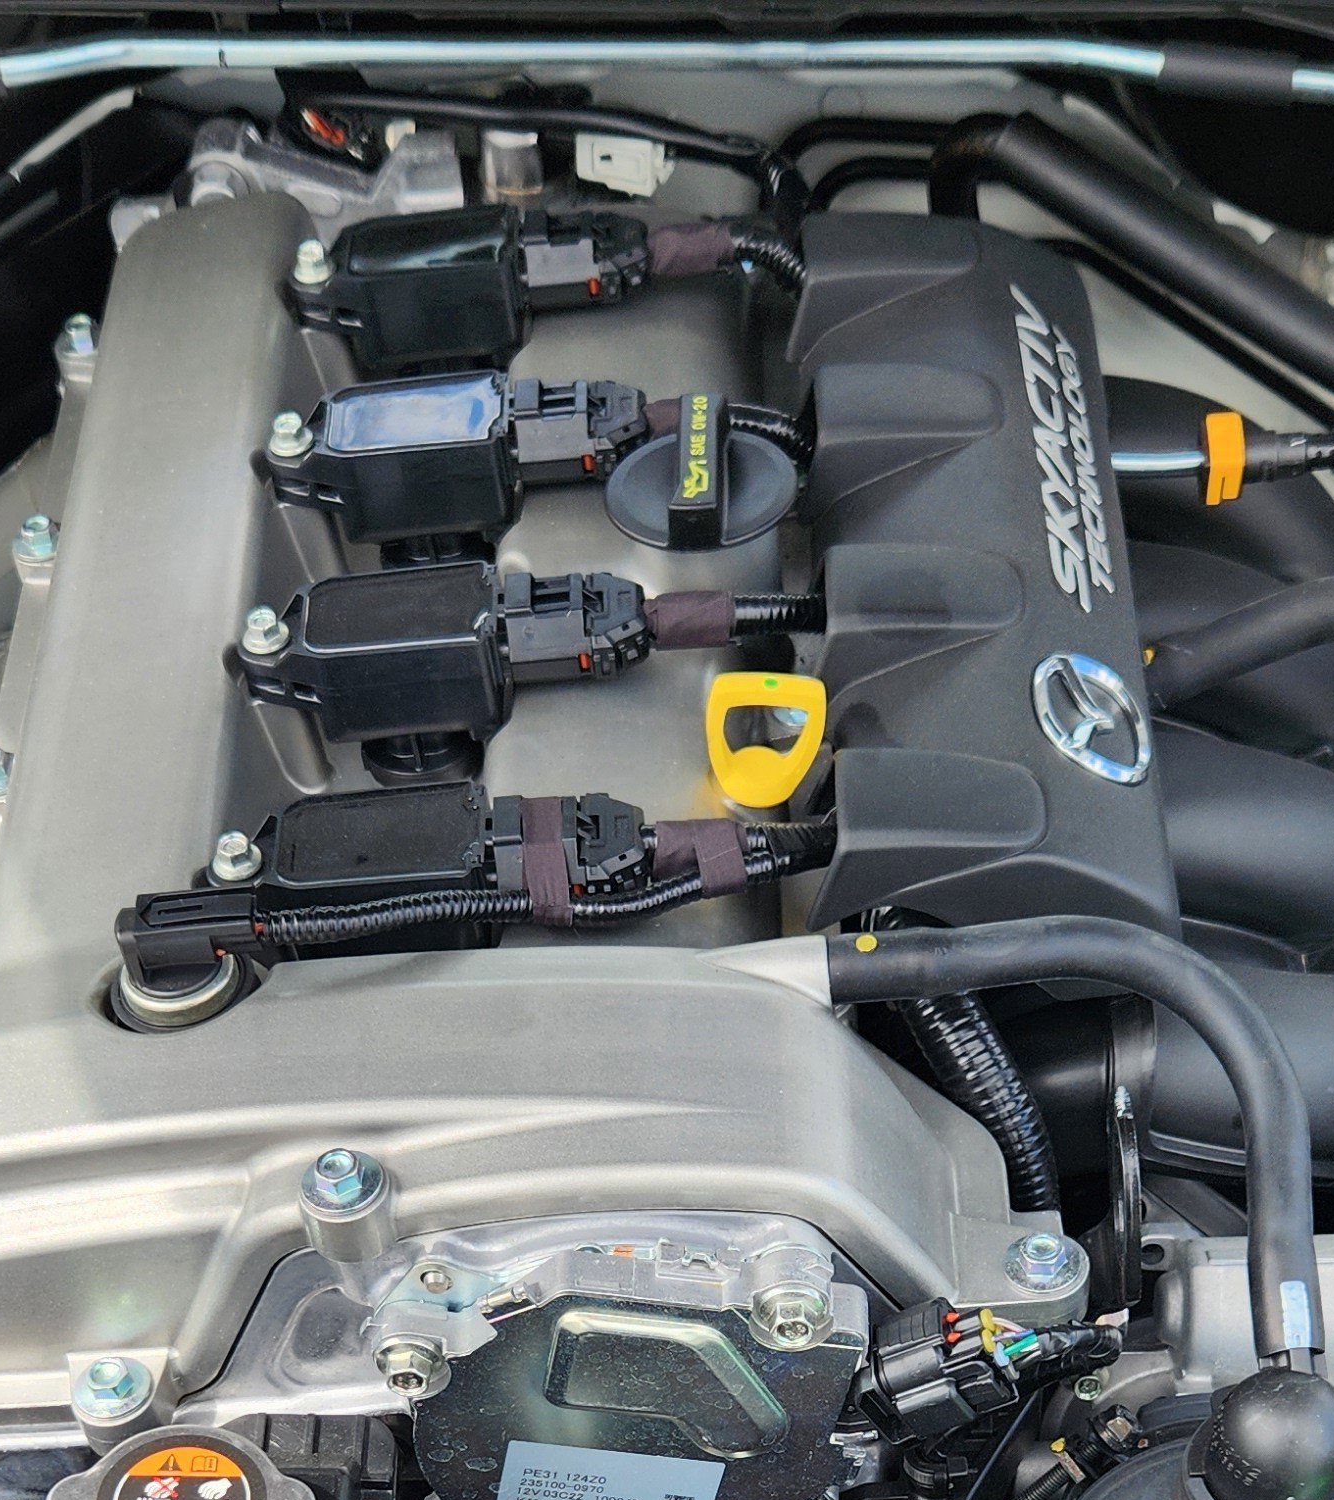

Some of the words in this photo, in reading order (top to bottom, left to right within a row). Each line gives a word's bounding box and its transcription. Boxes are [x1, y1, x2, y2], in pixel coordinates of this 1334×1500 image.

[690, 395, 708, 430] 0W-20
[689, 434, 707, 456] SAE
[1009, 283, 1093, 613] SKYACTIV
[1052, 322, 1116, 593] TECHNOLOGY
[522, 1467, 559, 1480] PE31
[516, 1486, 542, 1497] 12V
[519, 1477, 605, 1494] 235100-0970
